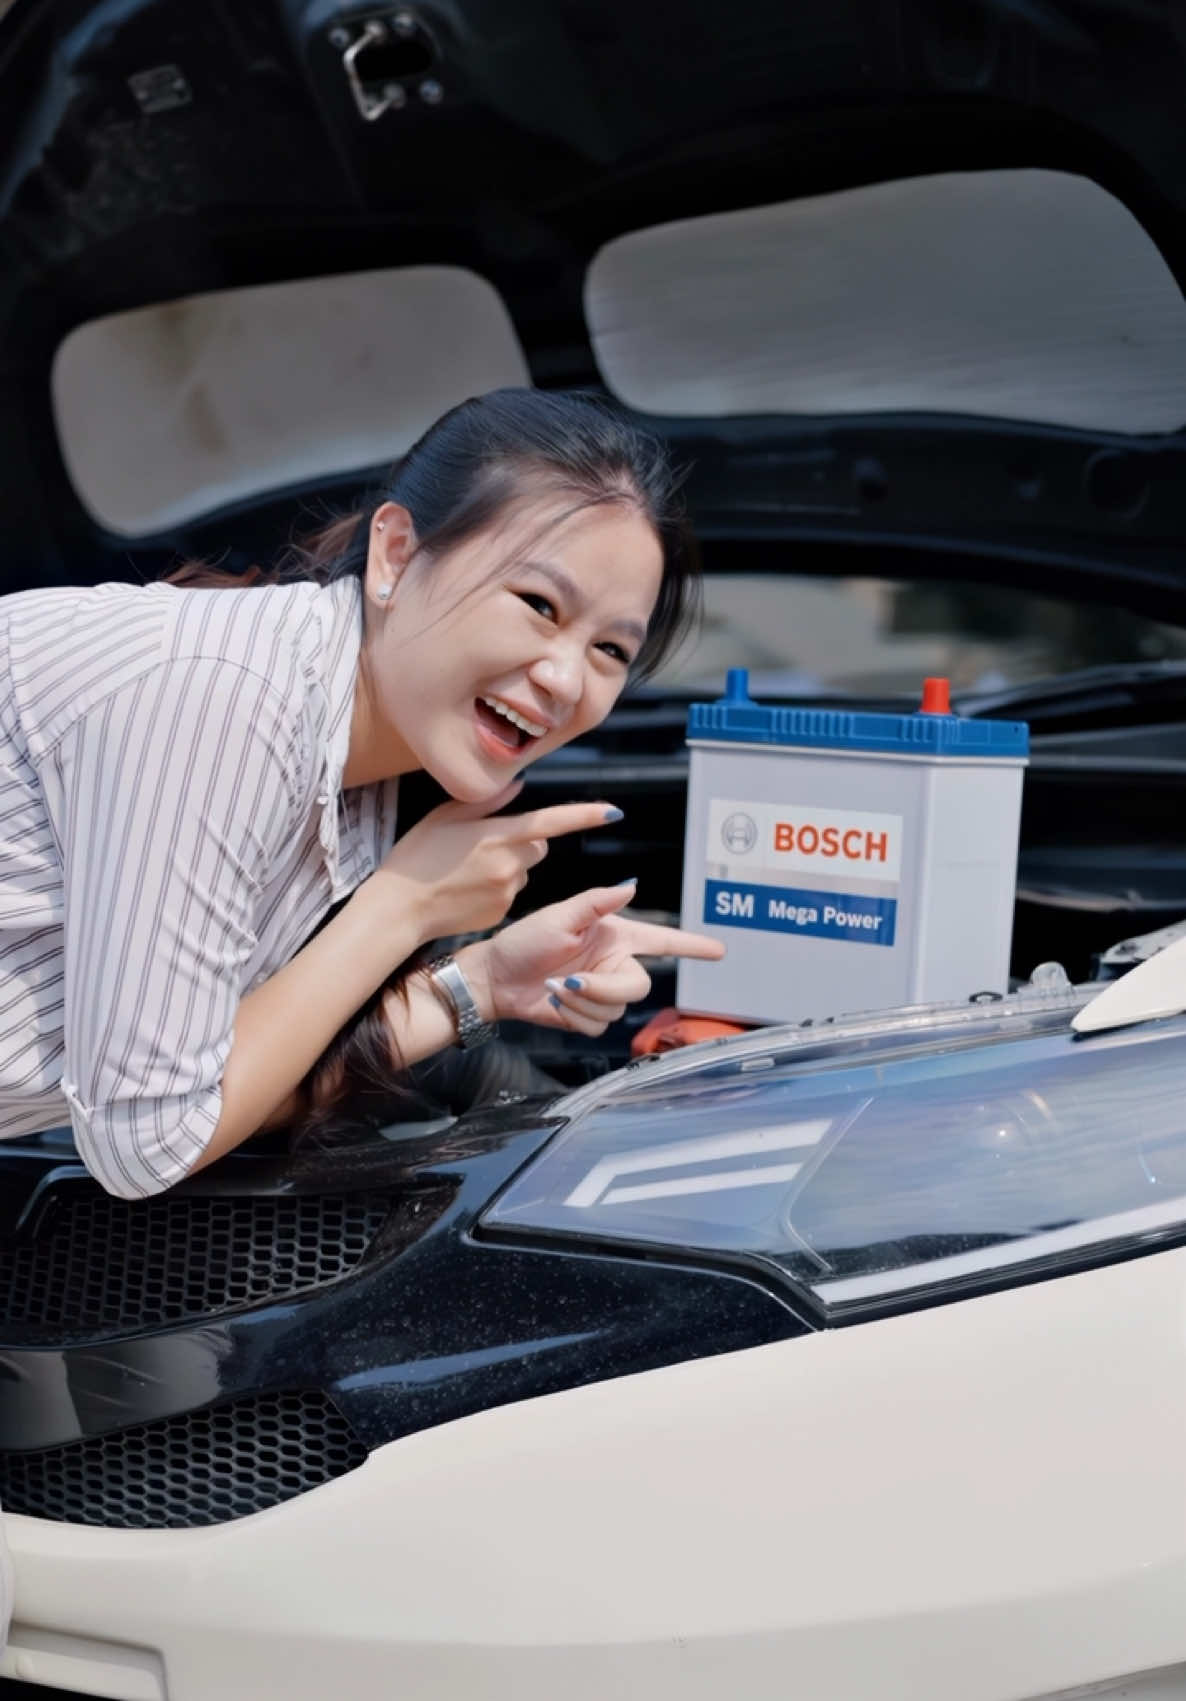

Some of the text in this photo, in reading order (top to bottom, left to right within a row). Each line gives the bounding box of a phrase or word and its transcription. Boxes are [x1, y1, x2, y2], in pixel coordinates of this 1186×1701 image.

[773, 822, 888, 863] BOSCH
[715, 891, 883, 930] SM Mega Power
